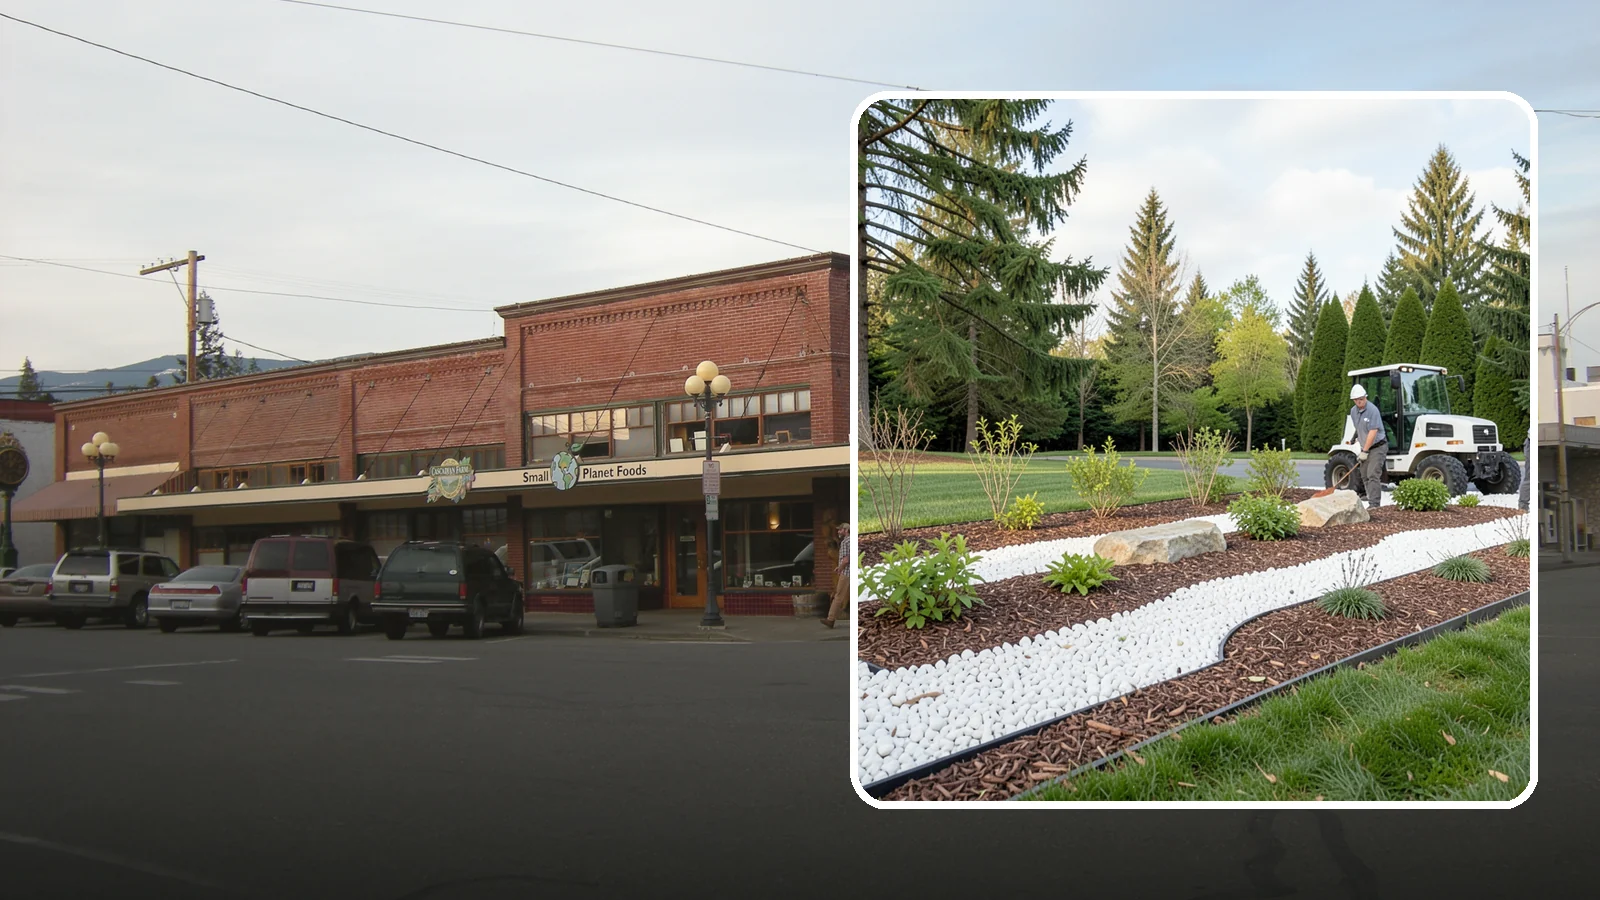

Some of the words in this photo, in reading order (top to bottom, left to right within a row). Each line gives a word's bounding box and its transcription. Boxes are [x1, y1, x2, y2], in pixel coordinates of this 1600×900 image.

[523, 471, 549, 483] Small
[583, 467, 614, 479] Planet
[617, 464, 647, 477] Foods
